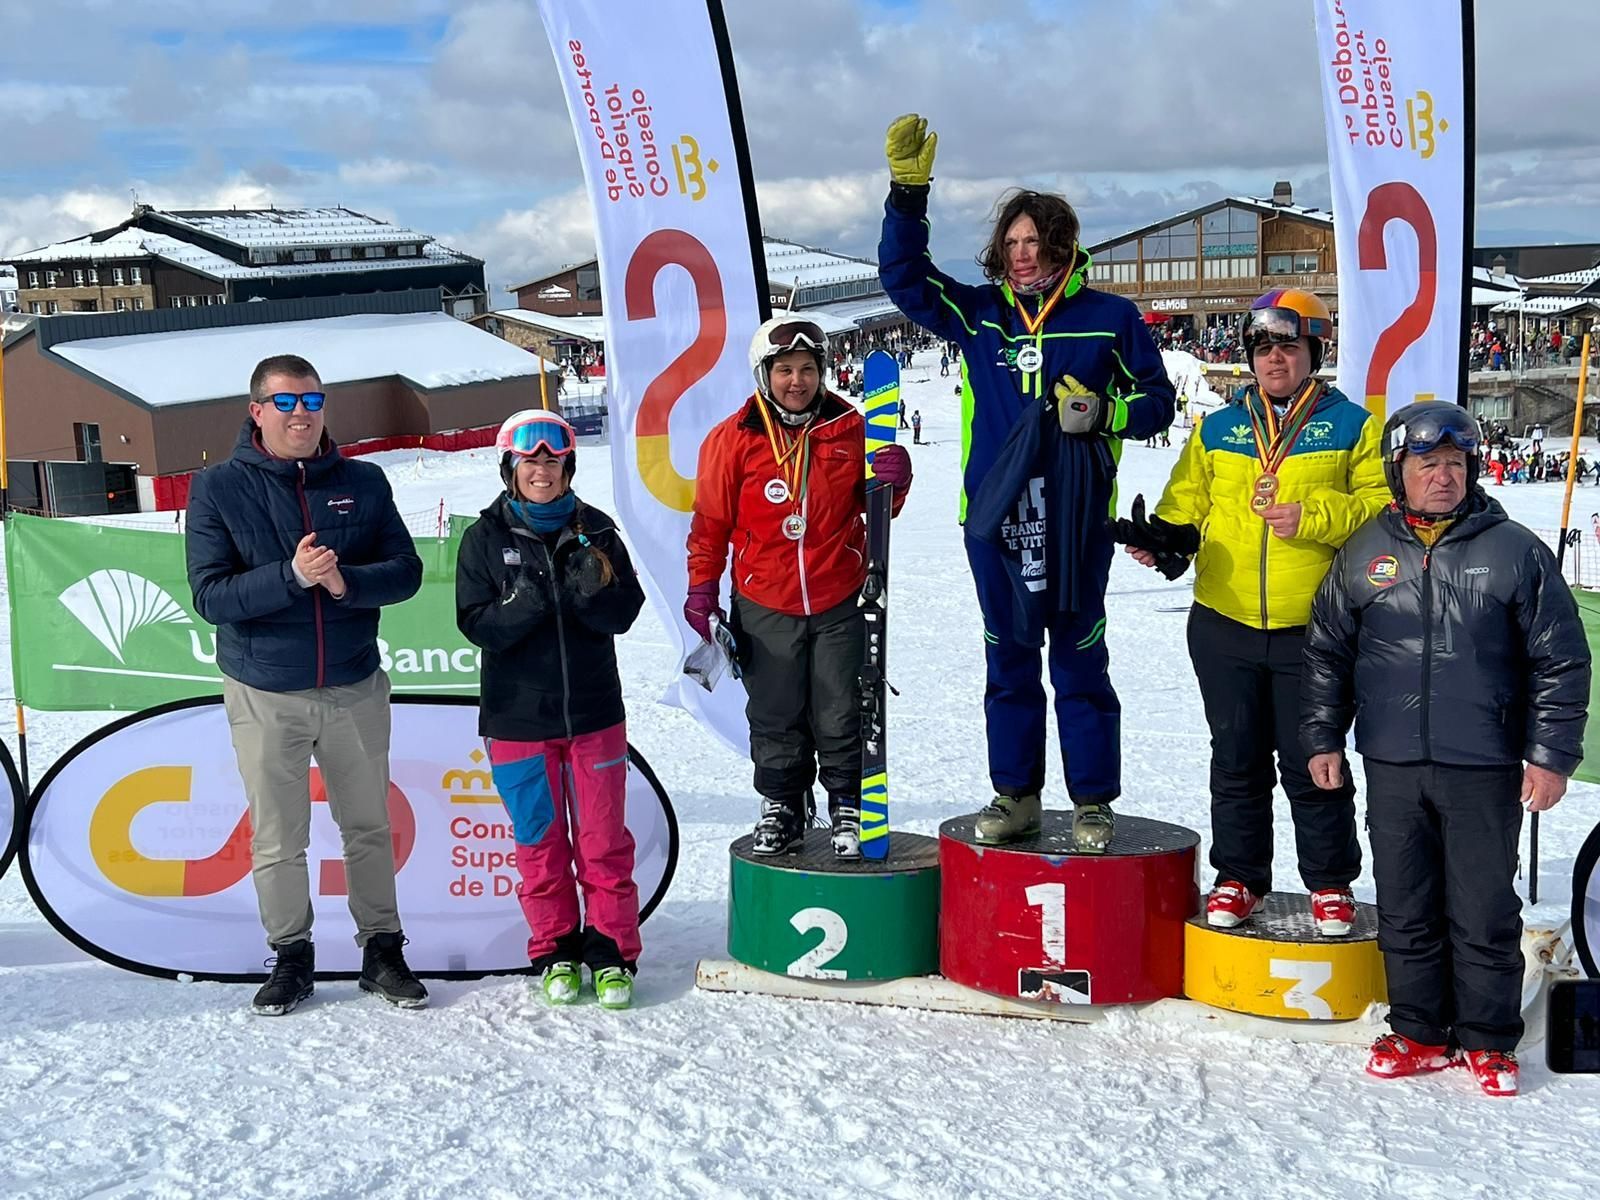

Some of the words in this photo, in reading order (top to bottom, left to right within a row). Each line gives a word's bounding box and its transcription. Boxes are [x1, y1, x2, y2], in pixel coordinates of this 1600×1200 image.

[376, 638, 482, 673] Banc
[451, 845, 517, 873] Supe
[449, 874, 484, 897] de
[787, 907, 849, 980] 2
[1024, 882, 1066, 969] 1
[1269, 958, 1332, 1020] 3
